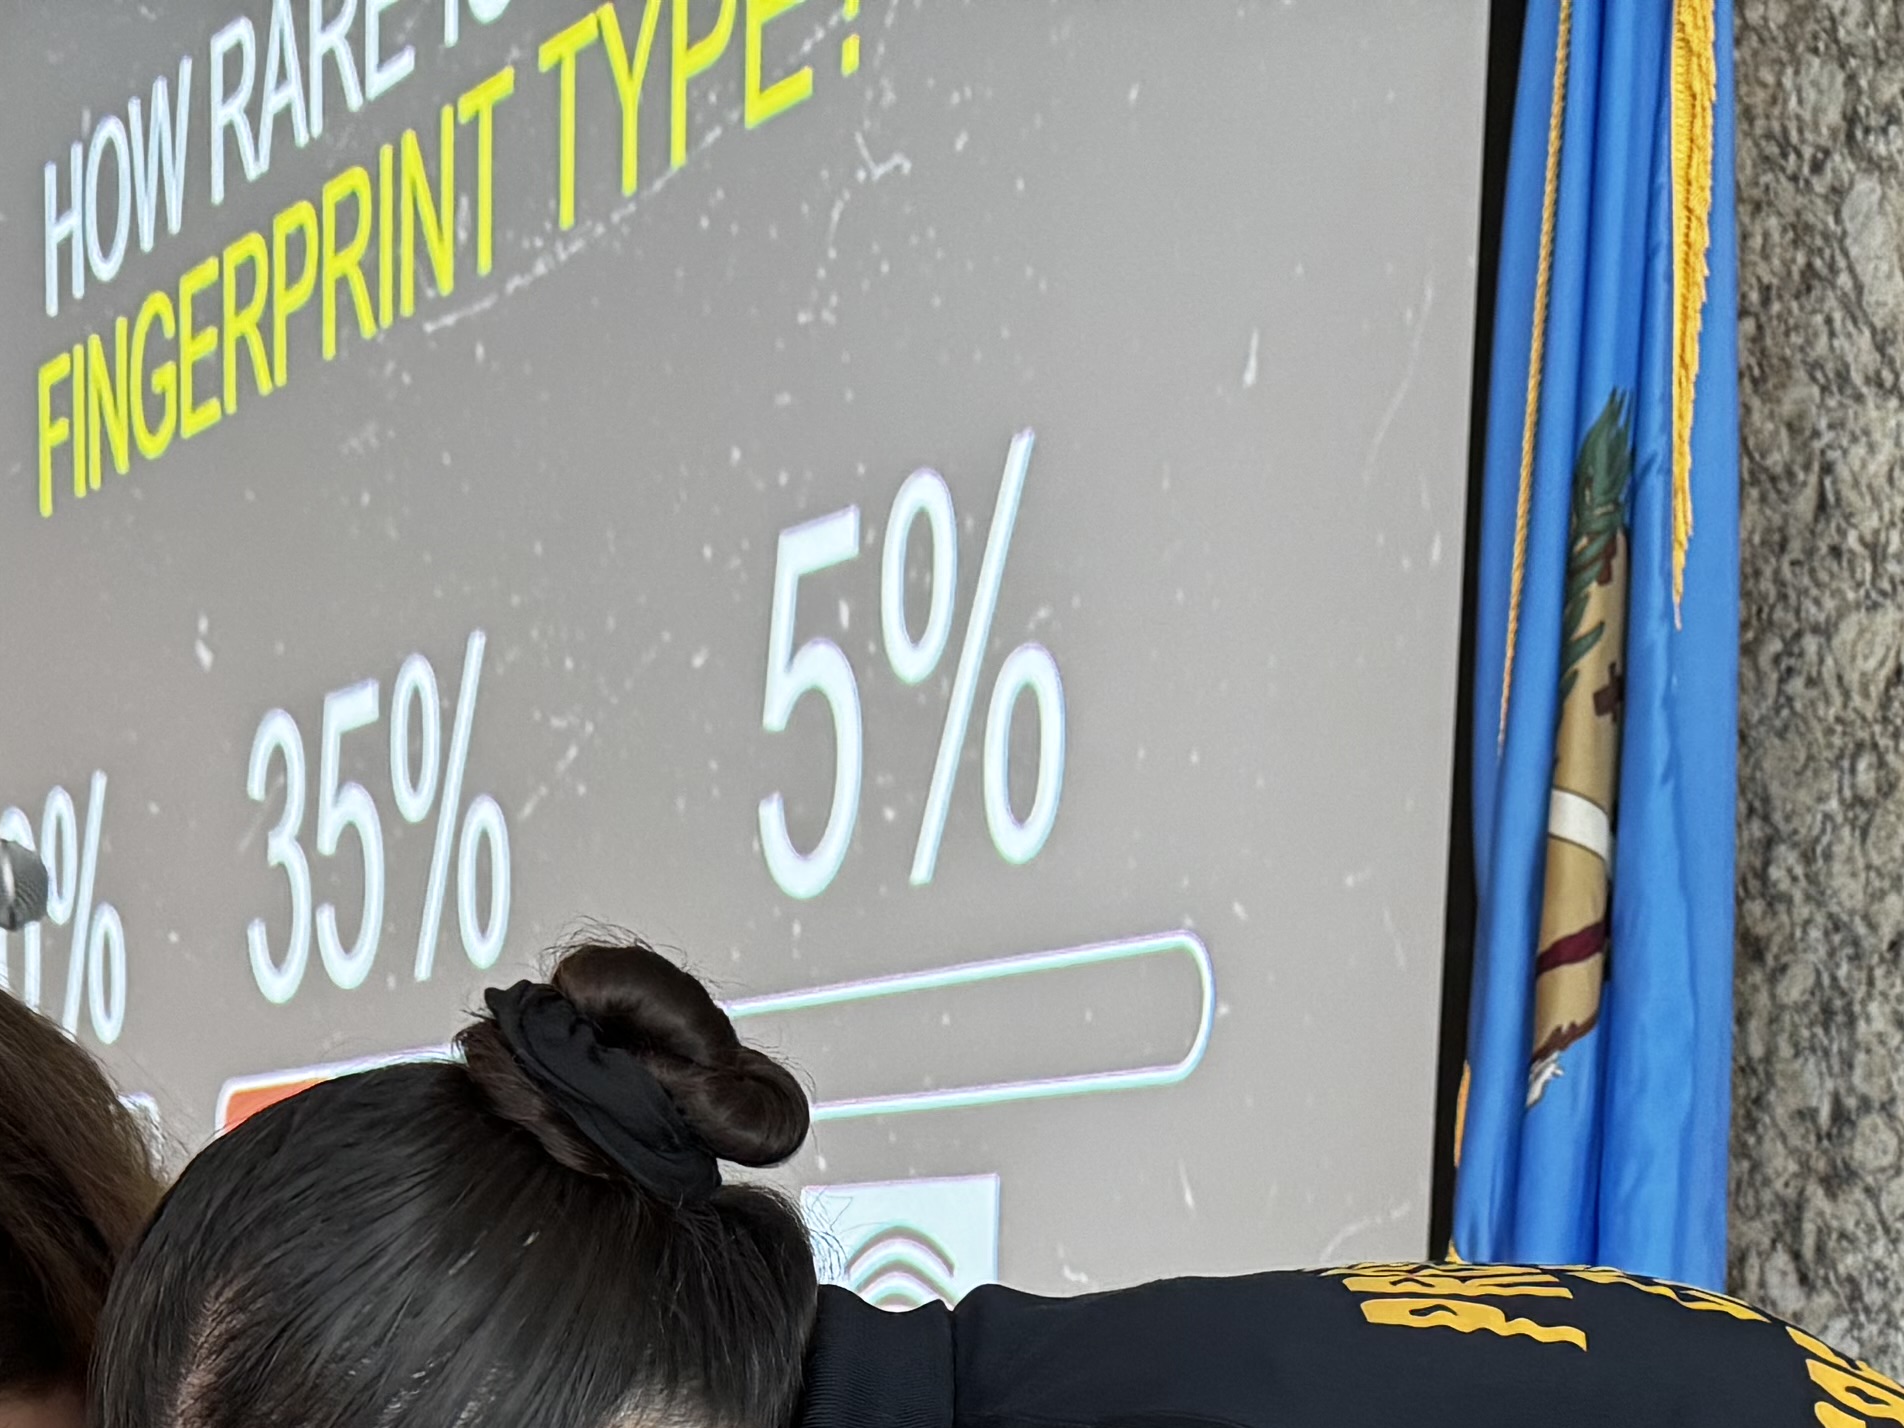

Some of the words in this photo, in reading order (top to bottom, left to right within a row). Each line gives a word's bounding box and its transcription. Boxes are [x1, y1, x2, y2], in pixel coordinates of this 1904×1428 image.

[37, 65, 516, 518] FINGERPRINT
[44, 55, 194, 318] HOW
[209, 0, 416, 204] RARE
[245, 628, 512, 1004] 35%
[756, 428, 1066, 900] 5%
